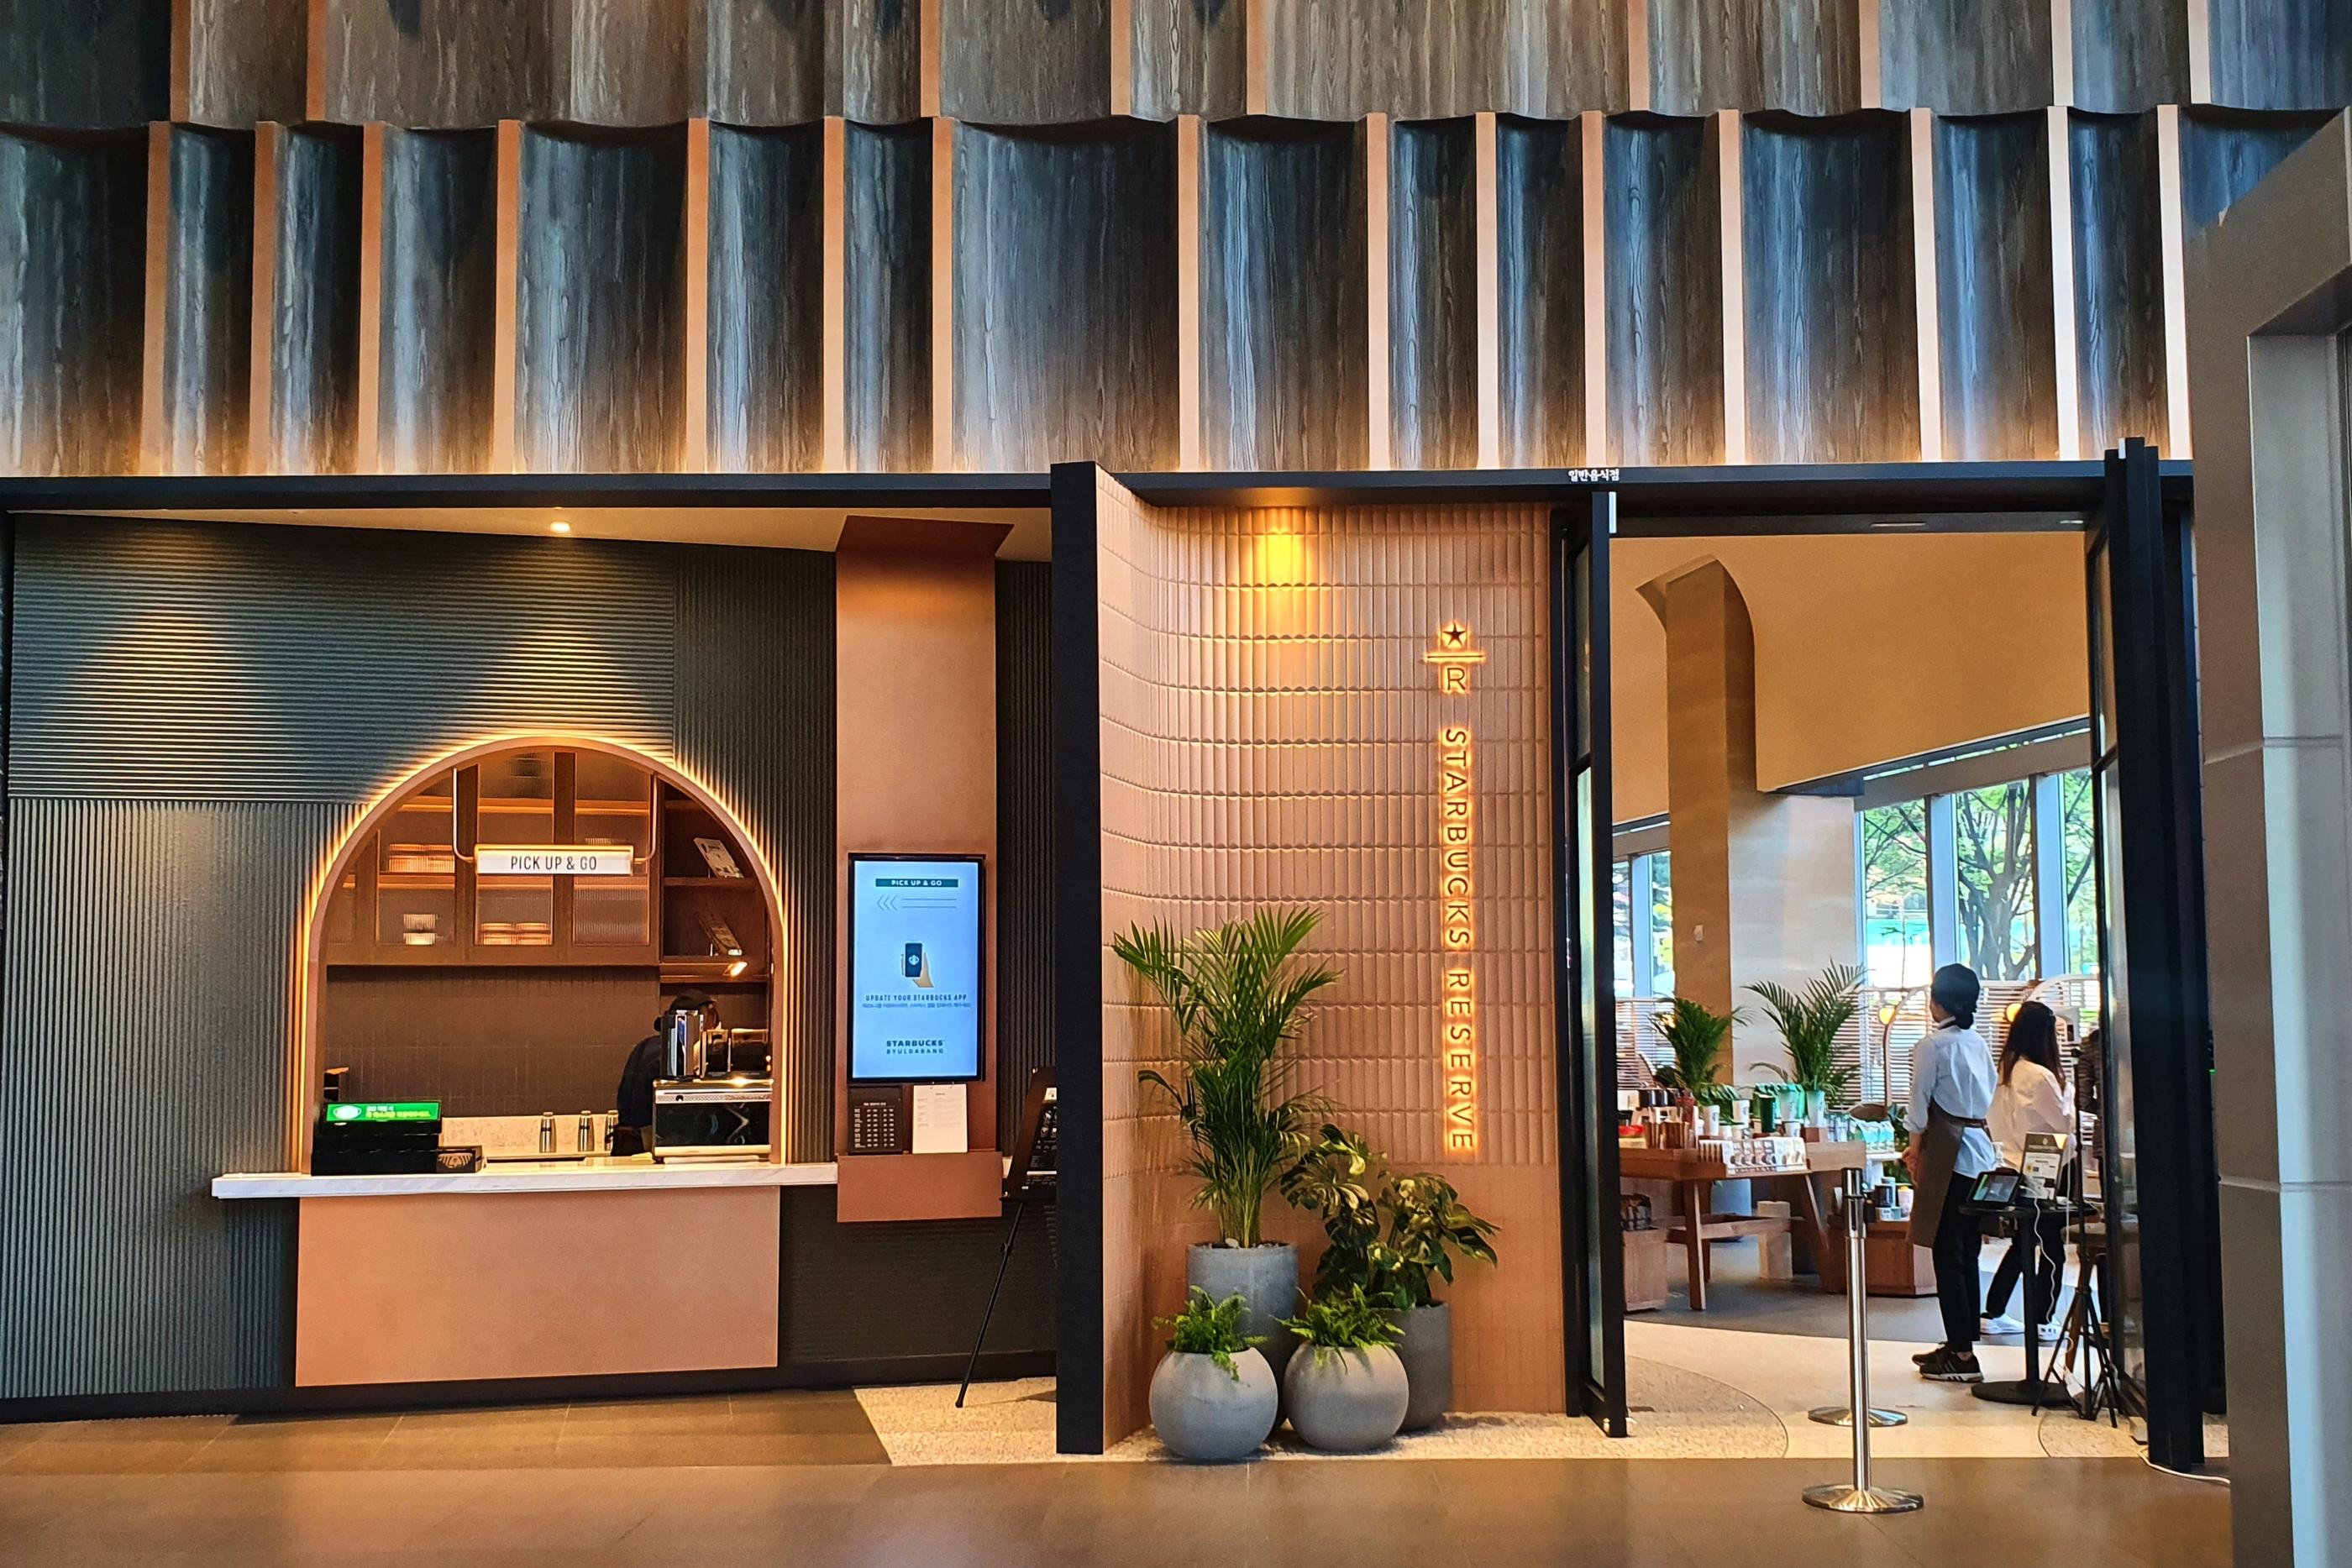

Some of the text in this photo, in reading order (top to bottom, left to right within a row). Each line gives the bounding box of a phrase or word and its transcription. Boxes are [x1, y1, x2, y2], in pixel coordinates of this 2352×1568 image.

[1567, 469, 1620, 482] 일반음식점
[1446, 667, 1467, 690] R
[511, 856, 597, 870] PICK UP & GO
[1446, 728, 1473, 1148] STARBUCKS RESERVE
